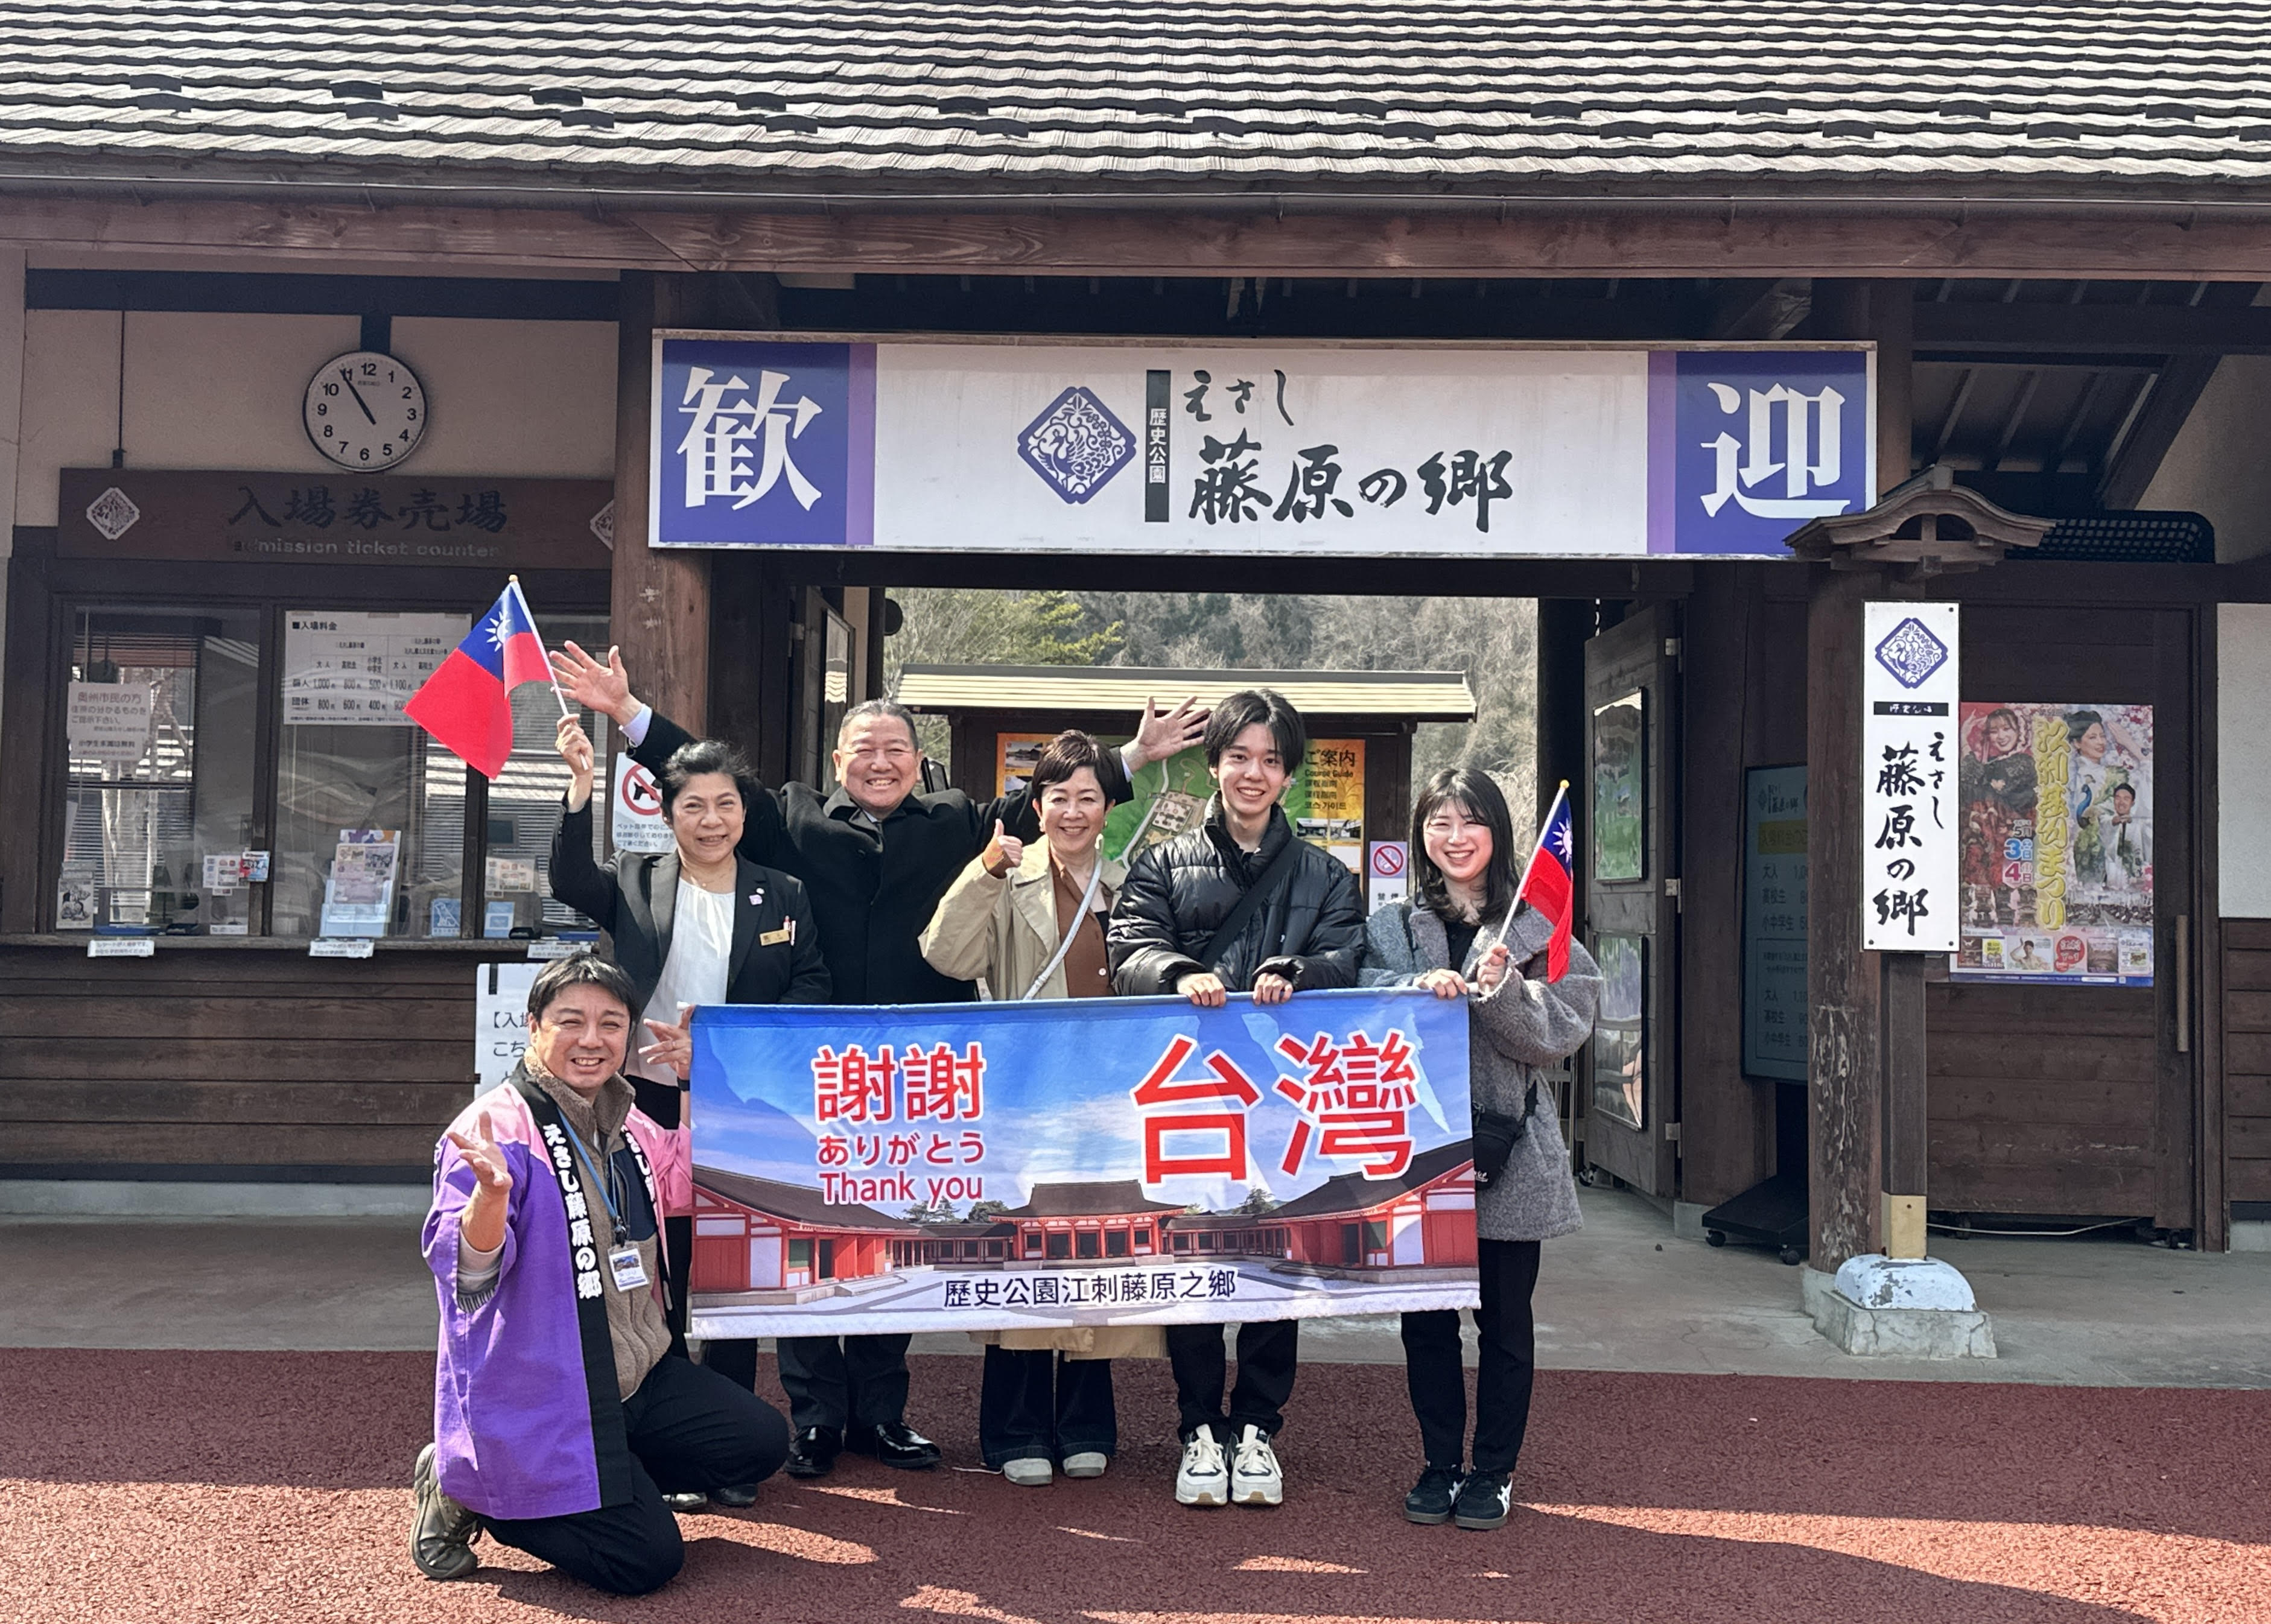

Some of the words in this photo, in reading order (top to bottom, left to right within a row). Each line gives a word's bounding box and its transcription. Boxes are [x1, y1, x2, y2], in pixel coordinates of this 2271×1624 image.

[340, 368, 353, 381] 11
[362, 363, 376, 376] 12
[388, 370, 394, 382] 1
[323, 384, 339, 396] 10
[402, 387, 411, 399] 2
[1184, 369, 1294, 427] えさし
[317, 404, 327, 416] 9
[407, 408, 416, 420] 3
[324, 425, 333, 437] 8
[399, 429, 409, 442] 4
[677, 366, 822, 512] 歓
[339, 441, 349, 452] 7
[360, 448, 369, 460] 6
[383, 444, 392, 455] 5
[1148, 408, 1167, 484] 歴史公園
[1700, 382, 1851, 519] 迎
[1189, 428, 1513, 533] 藤原の郷
[228, 486, 507, 533] 入場券売場
[346, 540, 408, 556] ticket
[1304, 749, 1355, 767] ご案内
[1928, 732, 1945, 829] えさし
[1872, 741, 1930, 936] 藤原の郷
[814, 1045, 984, 1122] 謝謝
[1133, 1032, 1416, 1184] 台灣
[818, 1132, 984, 1166] ありがとう
[819, 1170, 916, 1202] Thank
[927, 1176, 983, 1210] you
[543, 1123, 603, 1299] えさし藤原の郷
